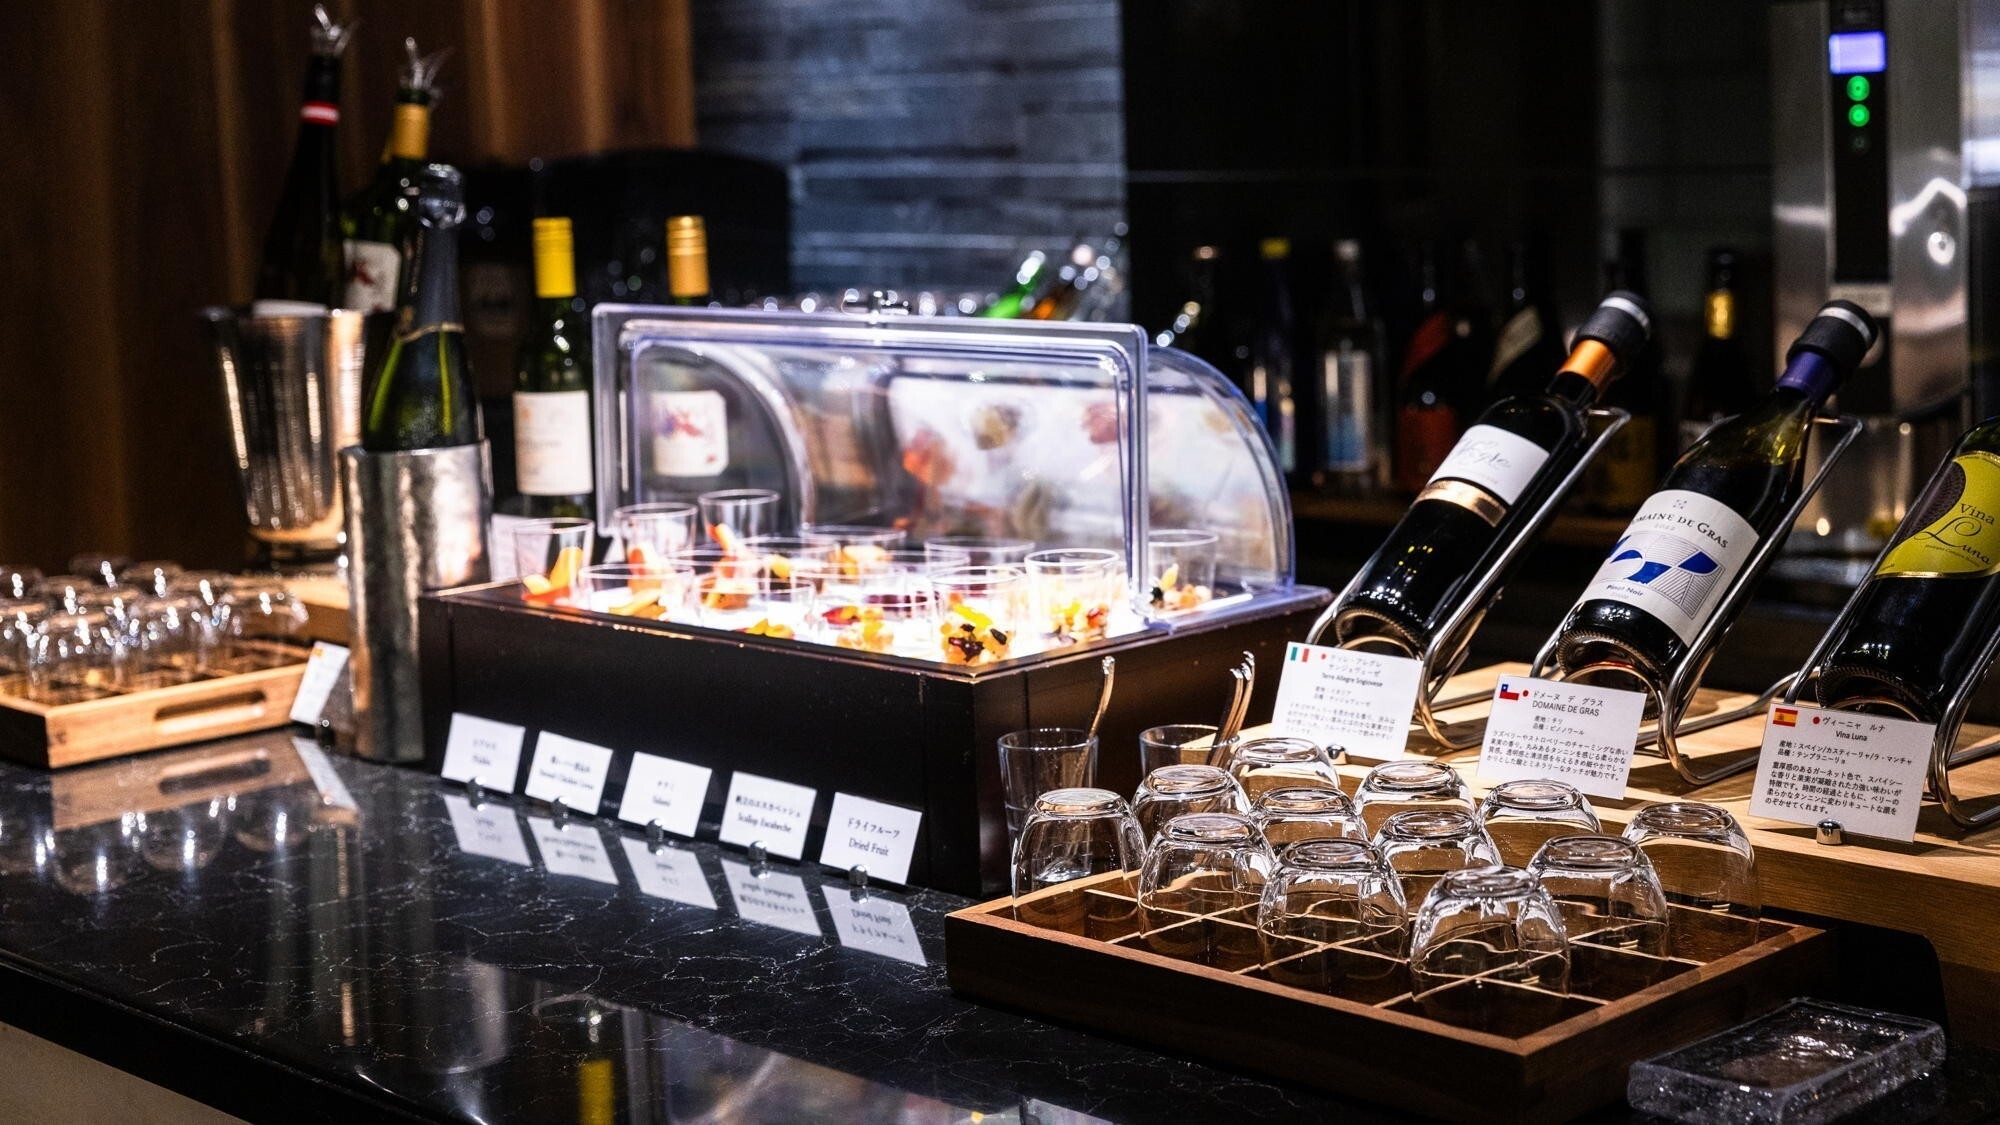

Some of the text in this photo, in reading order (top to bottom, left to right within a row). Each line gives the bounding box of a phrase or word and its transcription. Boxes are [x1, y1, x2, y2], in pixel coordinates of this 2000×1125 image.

[1961, 503, 1995, 526] Vina
[1632, 513, 1729, 549] MAINE DE GRAS
[1914, 516, 1992, 565] Luna
[1627, 586, 1644, 597] Noir
[1533, 690, 1560, 701] ドメーヌ
[1582, 697, 1604, 707] グラス
[1532, 700, 1600, 717] DOMAINE DE GRAS
[1822, 715, 1886, 732] ヴィーニャ ルナ
[1835, 730, 1868, 742] Vina Luna
[847, 817, 901, 839] ドライフルーツ
[849, 837, 889, 857] Dried Fruit
